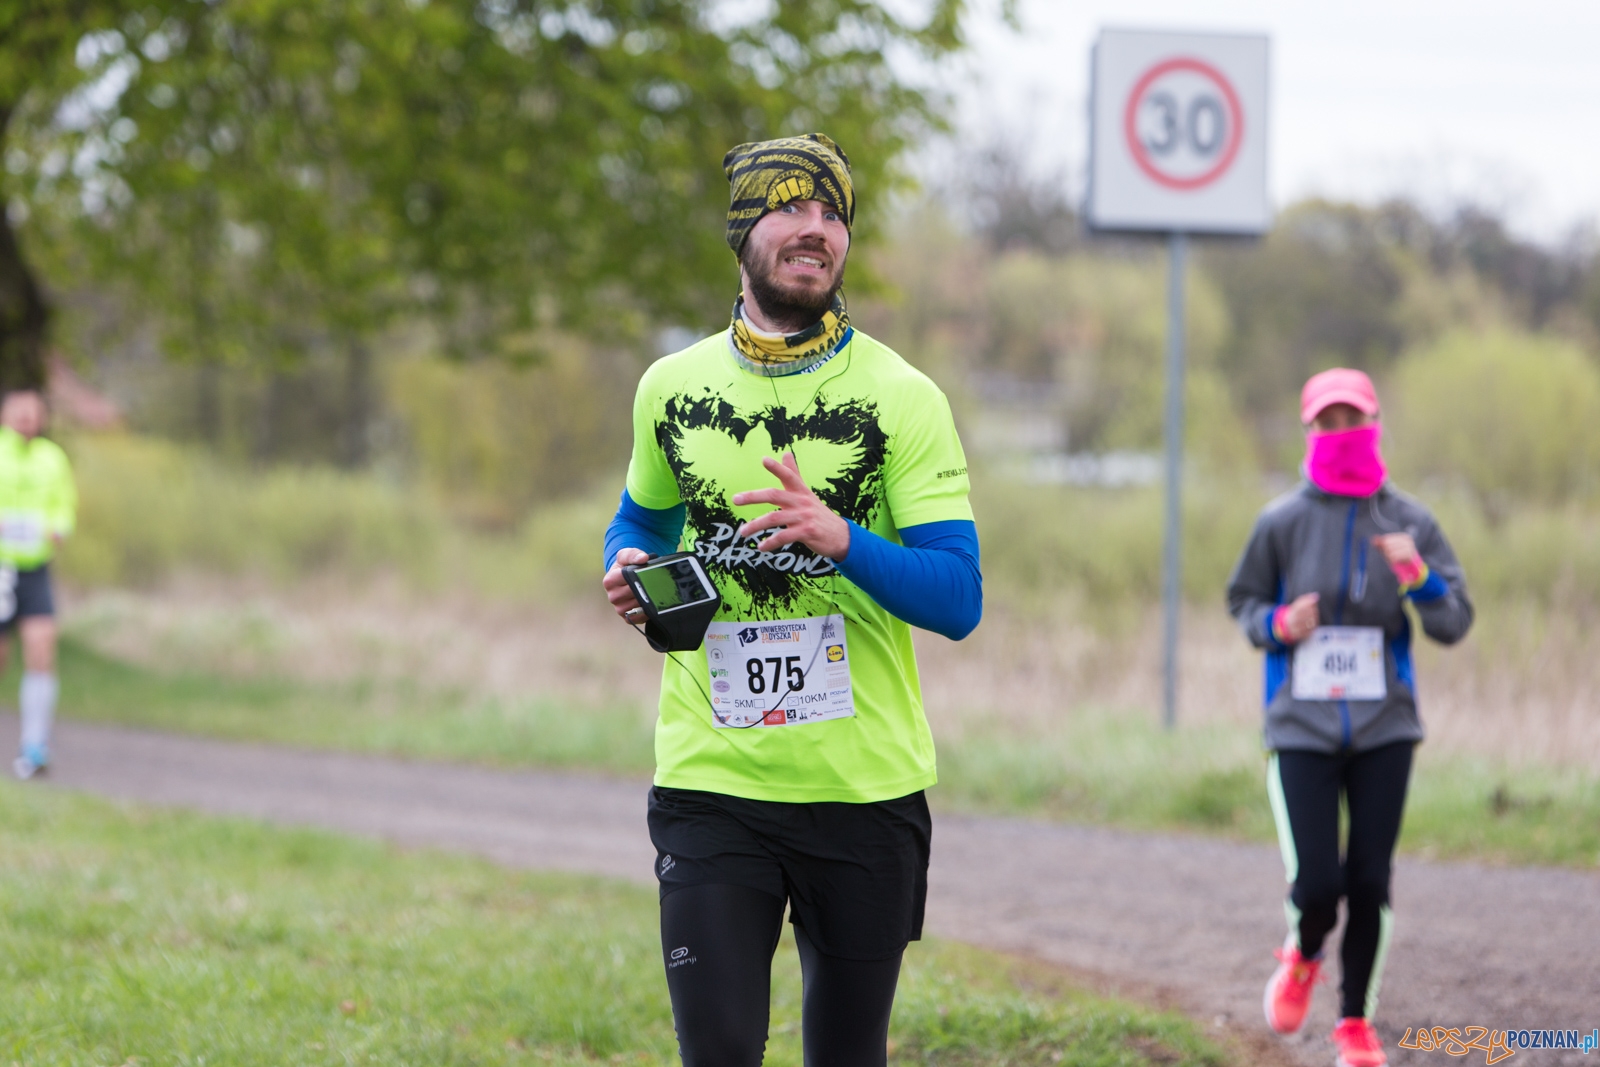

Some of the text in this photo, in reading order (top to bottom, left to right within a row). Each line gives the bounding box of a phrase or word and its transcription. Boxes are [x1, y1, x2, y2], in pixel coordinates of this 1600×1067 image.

[1145, 90, 1226, 158] 30
[760, 624, 807, 634] UNIWERSYTECKA
[746, 655, 805, 694] 875
[734, 699, 754, 708] 5KM
[799, 692, 828, 705] 10KM
